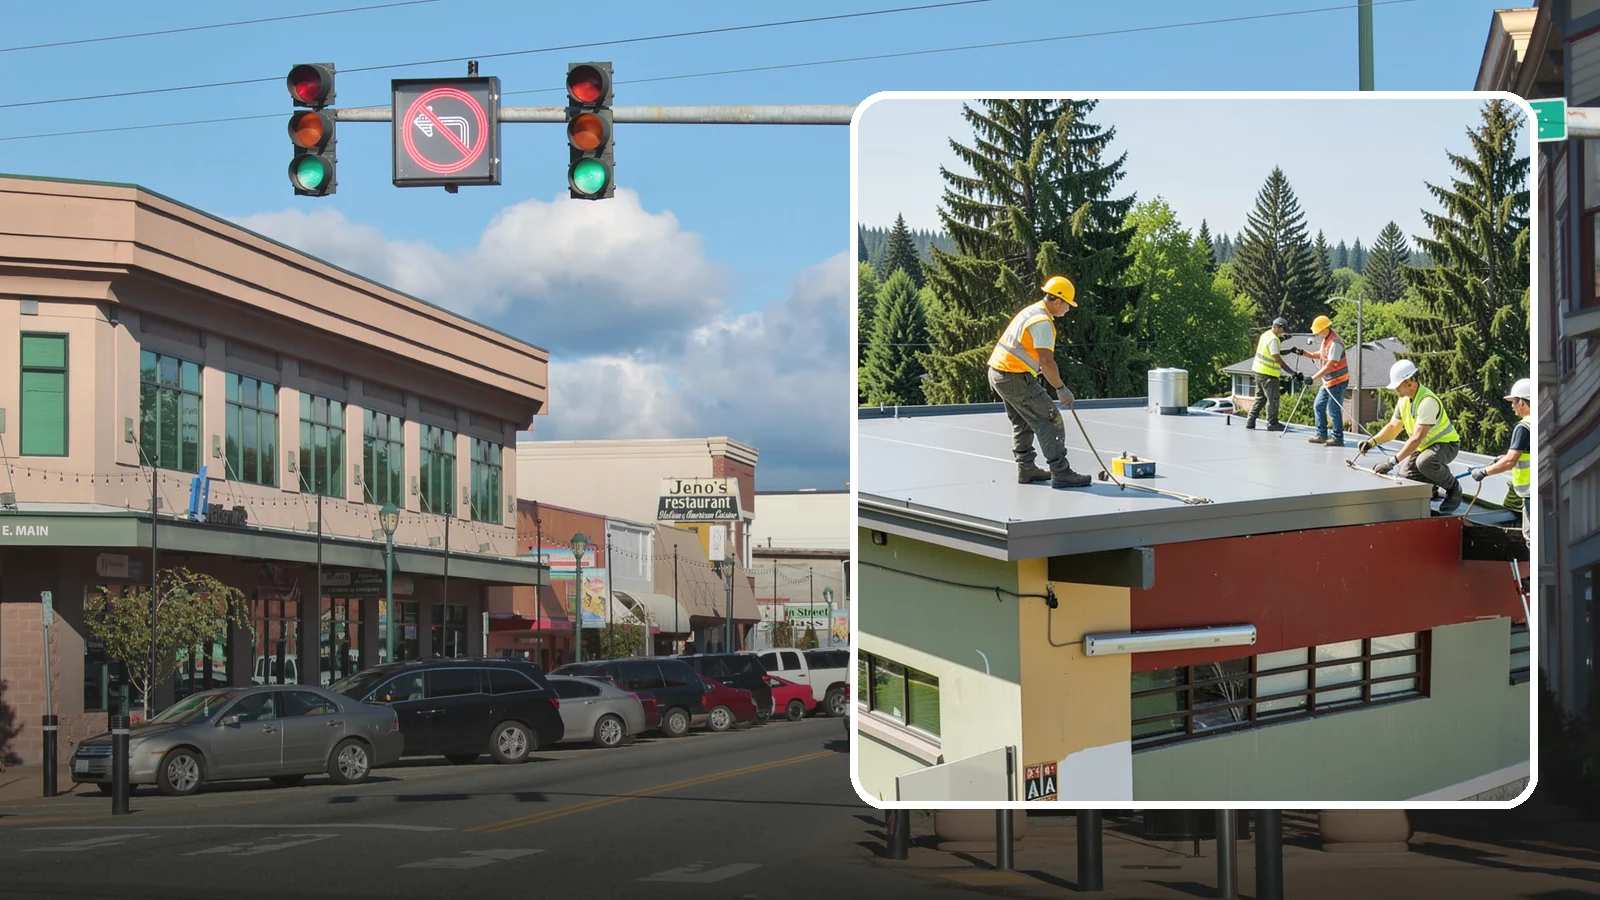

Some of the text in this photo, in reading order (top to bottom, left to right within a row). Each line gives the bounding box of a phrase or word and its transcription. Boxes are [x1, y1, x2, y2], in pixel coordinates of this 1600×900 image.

[669, 480, 727, 495] Jeno's
[665, 496, 731, 509] restaurant
[658, 509, 681, 519] Italian
[686, 509, 714, 519] American
[715, 509, 737, 519] Cuisine
[2, 525, 49, 536] E. MAIN
[797, 608, 828, 617] Street
